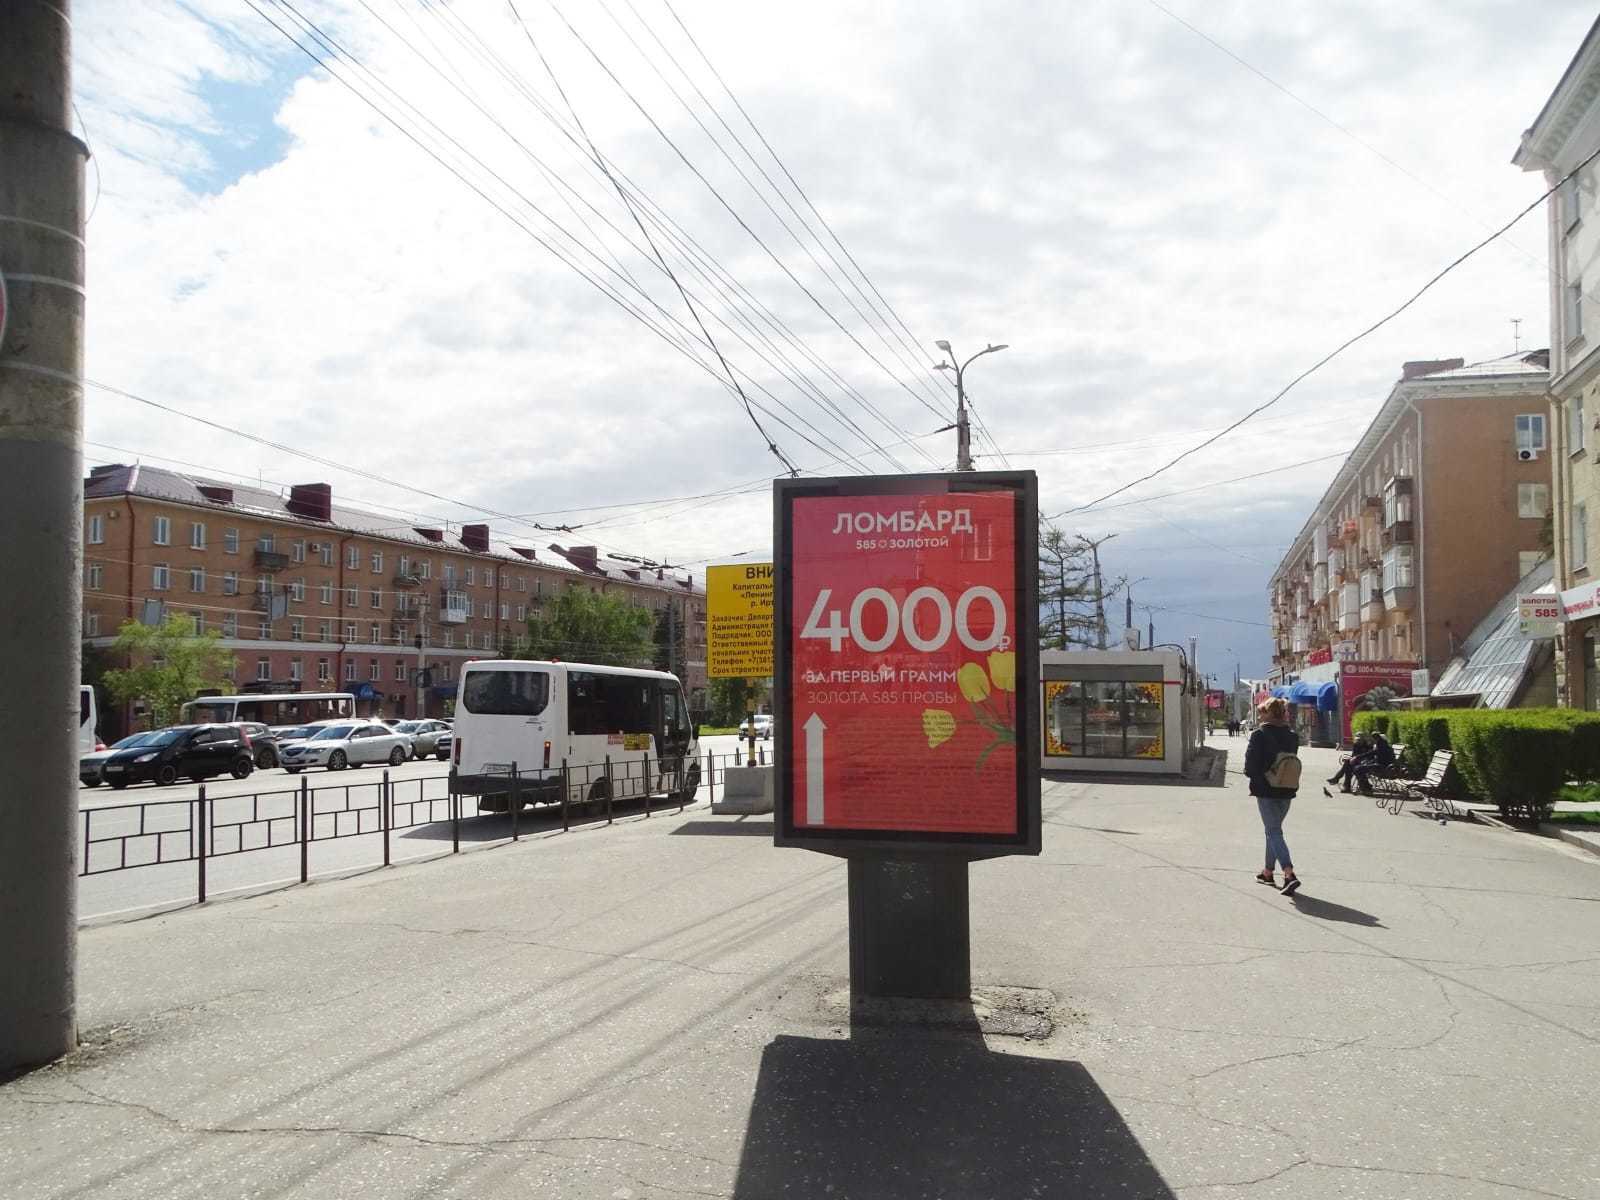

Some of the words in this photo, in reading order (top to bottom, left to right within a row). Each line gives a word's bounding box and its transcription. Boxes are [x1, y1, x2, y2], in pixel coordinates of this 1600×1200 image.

[832, 508, 973, 534] ЛОМБАРД
[856, 540, 877, 550] 585
[889, 536, 949, 549] ЗОЛОТОЙ
[1535, 608, 1558, 618] 585
[806, 671, 826, 684] ЗА
[830, 668, 896, 684] ПЕРВЫЙ
[900, 670, 957, 683] ГРАММ
[807, 691, 870, 704] ЗОЛОТА
[873, 691, 898, 704] 585
[902, 690, 957, 704] ПРОБЫ
